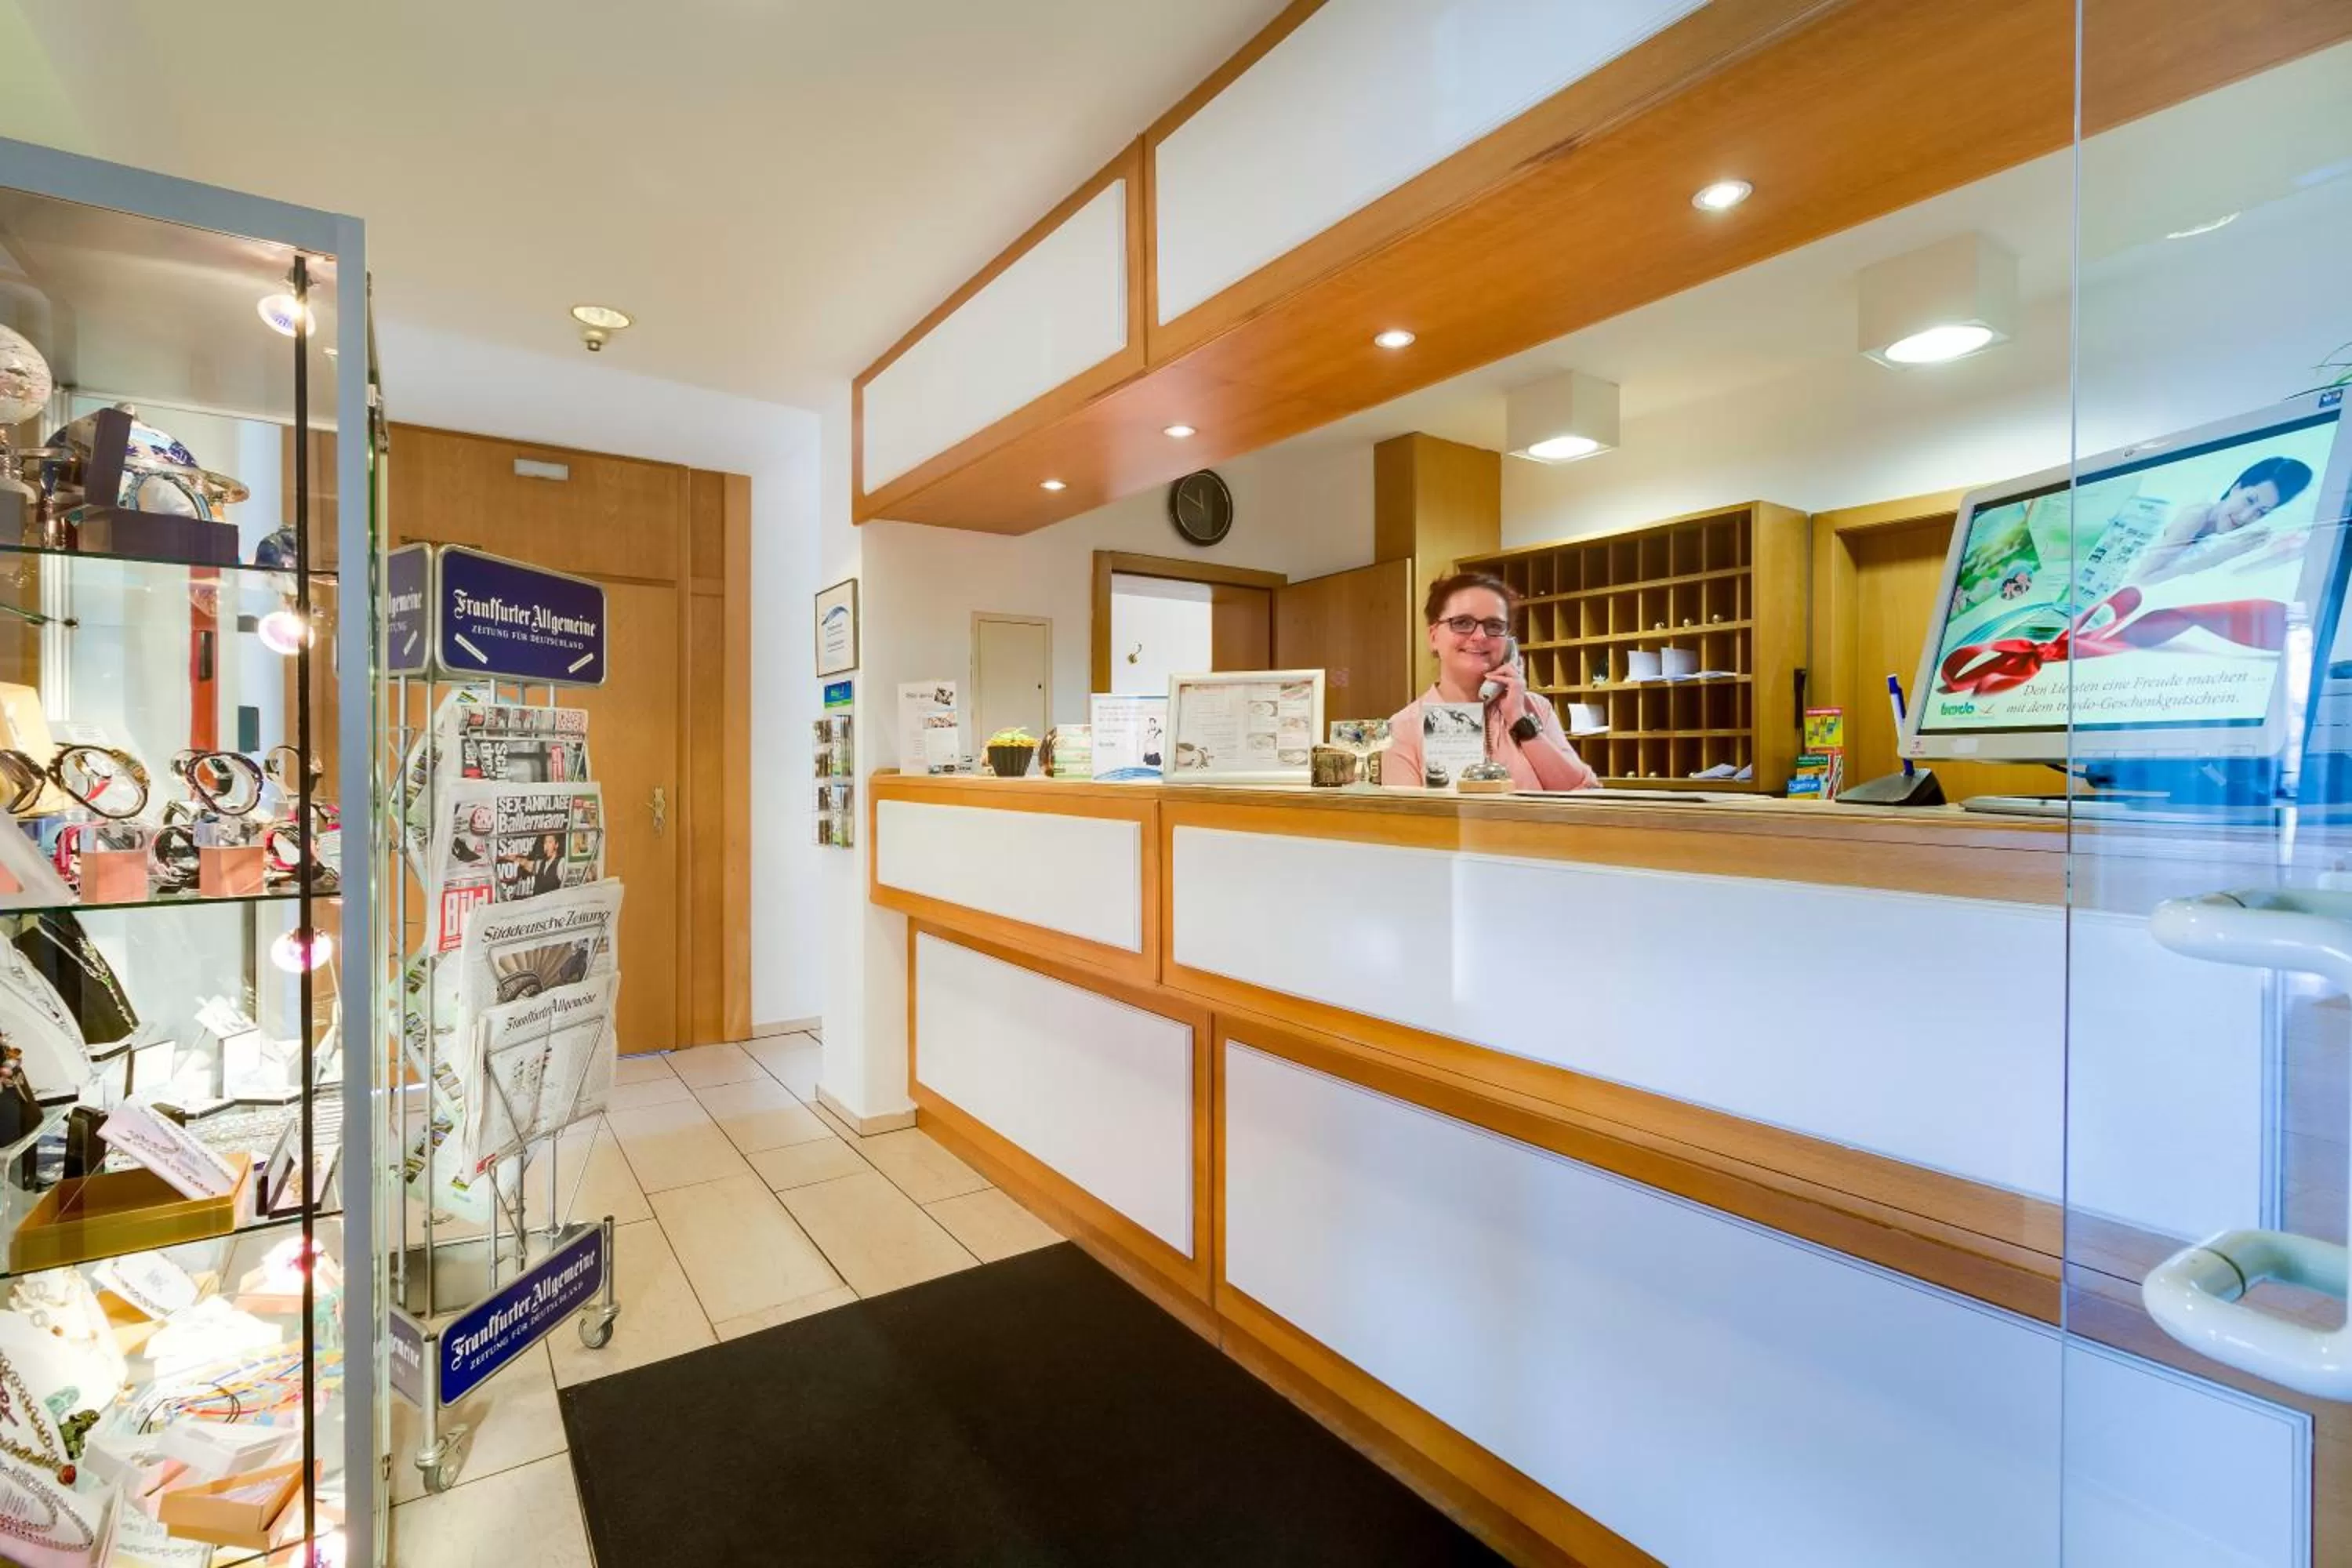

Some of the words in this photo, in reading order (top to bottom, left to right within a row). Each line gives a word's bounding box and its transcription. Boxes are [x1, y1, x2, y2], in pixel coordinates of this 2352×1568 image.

[453, 589, 531, 626] Frankfurter
[531, 604, 596, 637] Allgemeine
[471, 625, 509, 638] ZEITUNG
[530, 633, 584, 650] DEUTSCHLAND
[2023, 684, 2047, 696] Den
[2103, 678, 2130, 691] eine
[2133, 673, 2183, 690] Freude
[2186, 670, 2249, 685] machen
[2006, 702, 2025, 713] mit
[2027, 701, 2054, 713] dem
[481, 916, 570, 943] Süddeutsche
[570, 909, 612, 927] Zeitung
[451, 1296, 531, 1371] Frankfurter
[532, 1250, 596, 1313] Allgemeine
[470, 1336, 509, 1370] ZEITUNG
